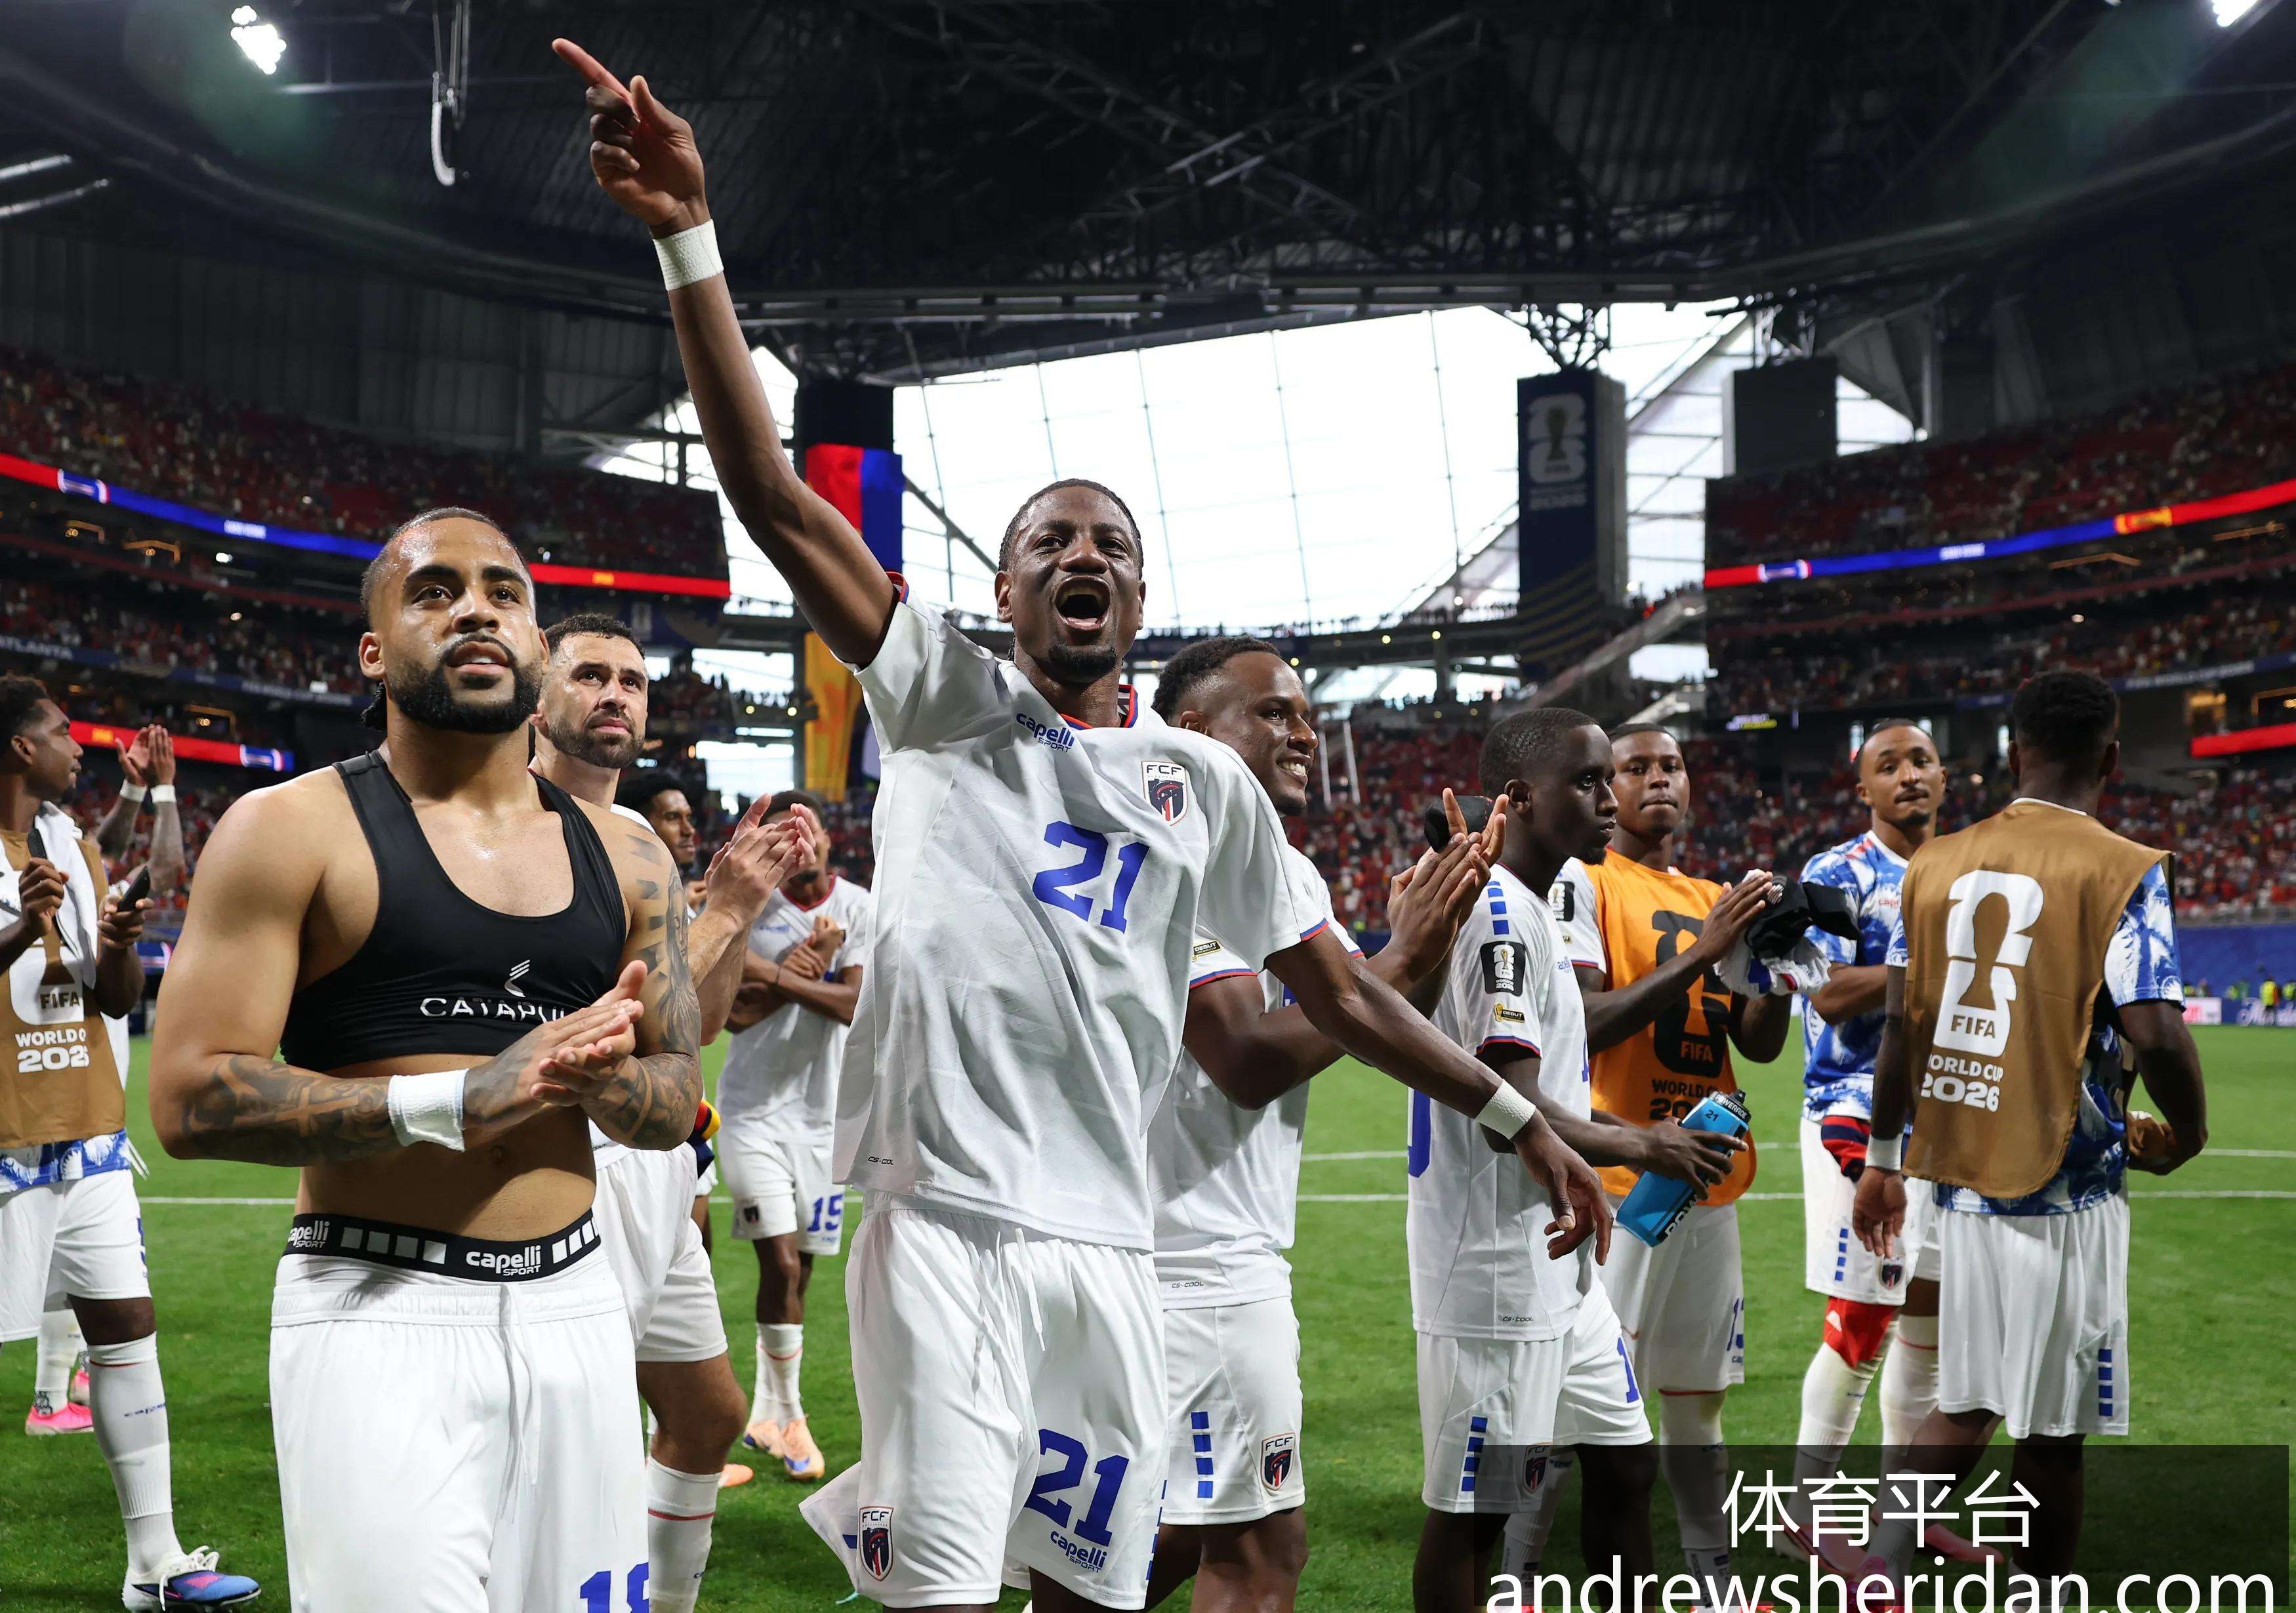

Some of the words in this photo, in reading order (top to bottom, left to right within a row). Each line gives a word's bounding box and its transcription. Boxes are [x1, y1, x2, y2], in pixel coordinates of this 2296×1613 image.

[1016, 712, 1075, 747] capelli
[1038, 737, 1072, 753] SPORT
[1147, 764, 1181, 775] FCF
[1032, 820, 1151, 935] 21
[1194, 942, 1217, 952] DEBUT
[40, 991, 80, 1009] FIFA
[1951, 1014, 1996, 1039] FIFA
[15, 1028, 77, 1048] WORLD
[1681, 1040, 1713, 1063] FIFA
[1928, 1053, 1982, 1076] ORLD
[1651, 1079, 1705, 1097] WORLD
[1706, 1109, 1719, 1122] 21
[1715, 1093, 1748, 1119] POWERADE
[806, 1193, 843, 1232] 15
[288, 1220, 330, 1246] apelli
[466, 1245, 541, 1274] capelli
[502, 1265, 541, 1276] SPORT
[1265, 1437, 1293, 1451] FCF
[1528, 1445, 1550, 1456] FCF
[1023, 1428, 1129, 1547] 21
[862, 1510, 889, 1522] FCF
[1050, 1530, 1107, 1568] capelli
[1069, 1557, 1102, 1573] SPORT
